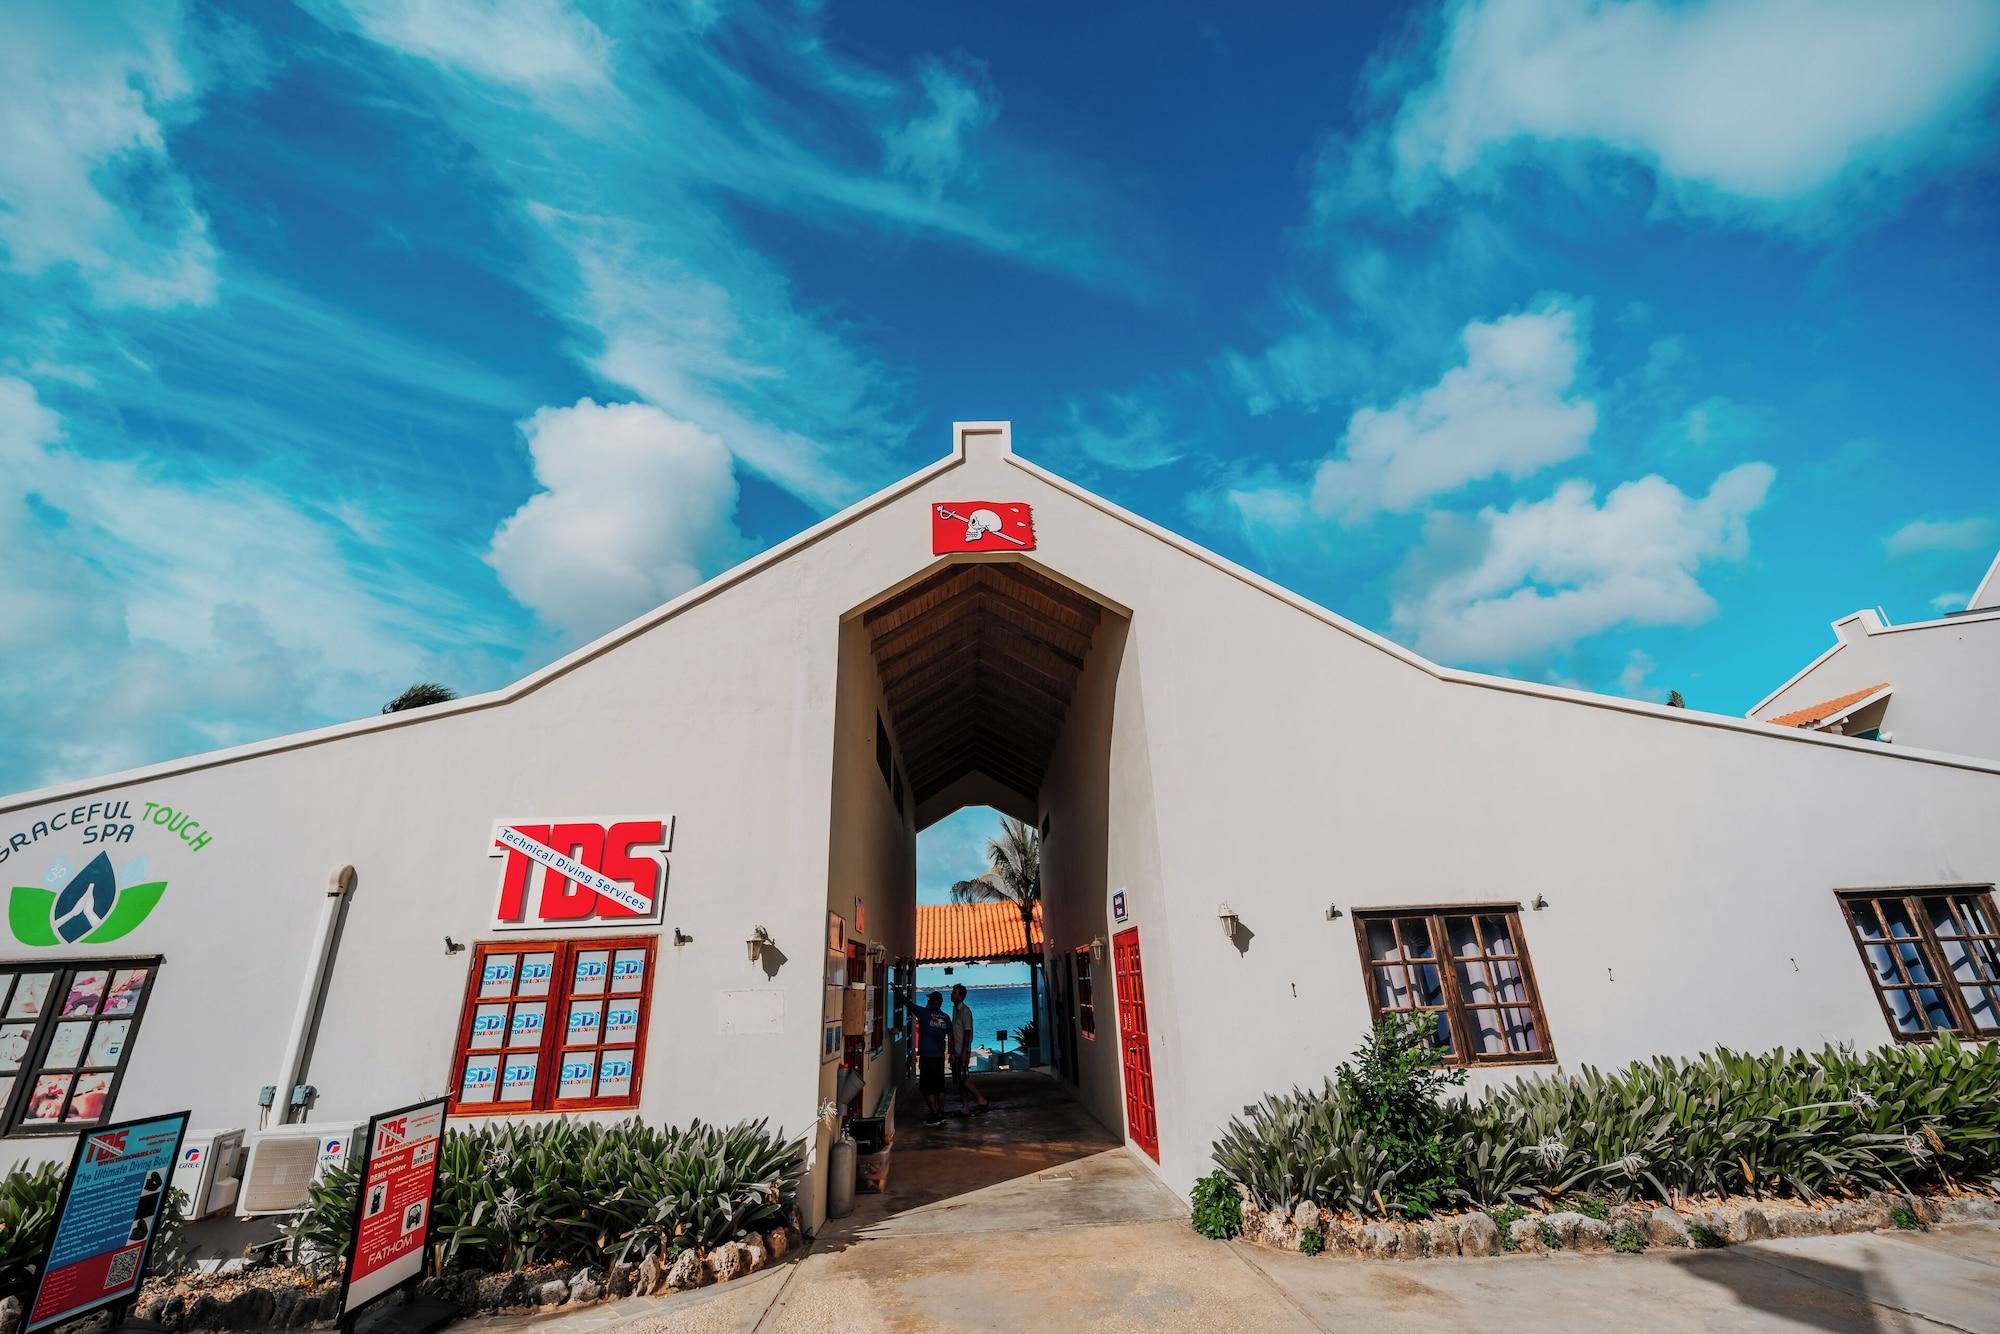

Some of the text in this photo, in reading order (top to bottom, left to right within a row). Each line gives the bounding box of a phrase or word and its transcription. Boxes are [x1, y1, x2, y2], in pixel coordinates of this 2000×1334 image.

[82, 823, 135, 845] SPA
[141, 802, 213, 852] TOUCH
[495, 821, 662, 920] TDS
[501, 828, 645, 910] Technical Diving Services
[484, 964, 515, 980] SDI
[521, 963, 552, 978] SDI
[576, 961, 607, 977] SDI
[613, 959, 644, 975] SDI
[475, 1014, 506, 1030] SDI
[513, 1013, 544, 1029] SDI
[569, 1011, 600, 1027] SDI
[607, 1009, 638, 1025] SDI
[465, 1066, 497, 1082] SDI
[503, 1065, 536, 1081] SDI
[562, 1063, 593, 1079] SDI
[600, 1060, 632, 1077] SDI
[378, 1117, 408, 1151] TDS
[85, 1129, 130, 1164] TDS
[373, 1154, 405, 1170] Rebreather
[76, 1173, 92, 1186] The
[93, 1164, 128, 1180] Ultimate
[129, 1158, 152, 1172] Diving
[369, 1170, 387, 1183] DEMO
[387, 1164, 407, 1176] Center
[367, 1233, 413, 1267] FATHOM
